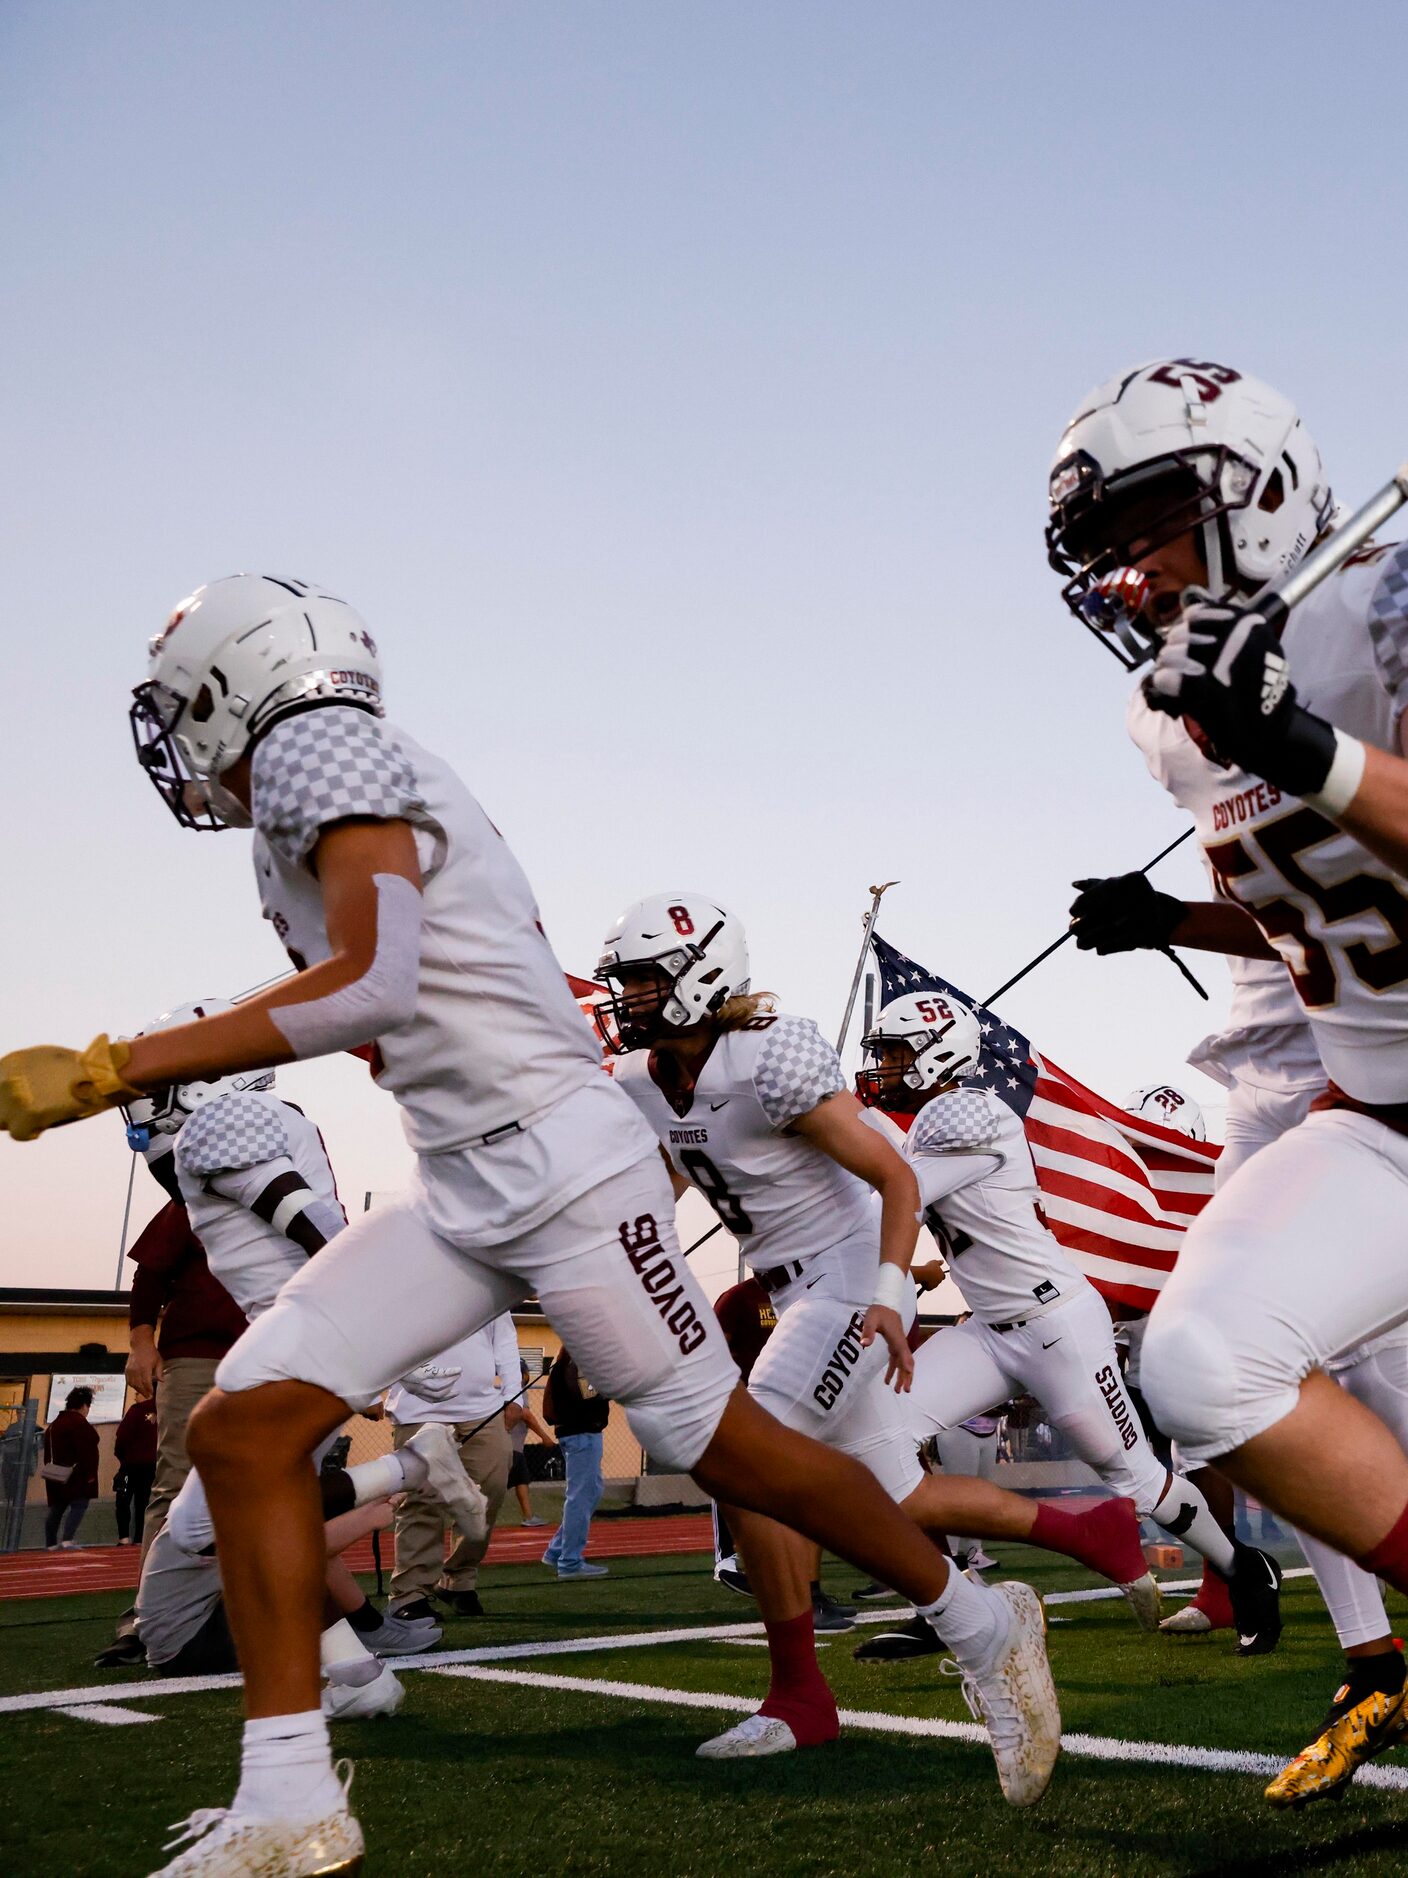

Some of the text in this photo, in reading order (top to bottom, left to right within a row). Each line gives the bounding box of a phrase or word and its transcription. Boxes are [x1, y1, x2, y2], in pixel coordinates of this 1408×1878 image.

[1212, 782, 1282, 832] COYOTES
[667, 905, 695, 936] 8
[915, 998, 955, 1023] 52
[669, 1129, 708, 1143] COYOTES
[680, 1149, 753, 1235] 8
[813, 1310, 866, 1411] COYOTE
[1095, 1365, 1138, 1451] COYOTES
